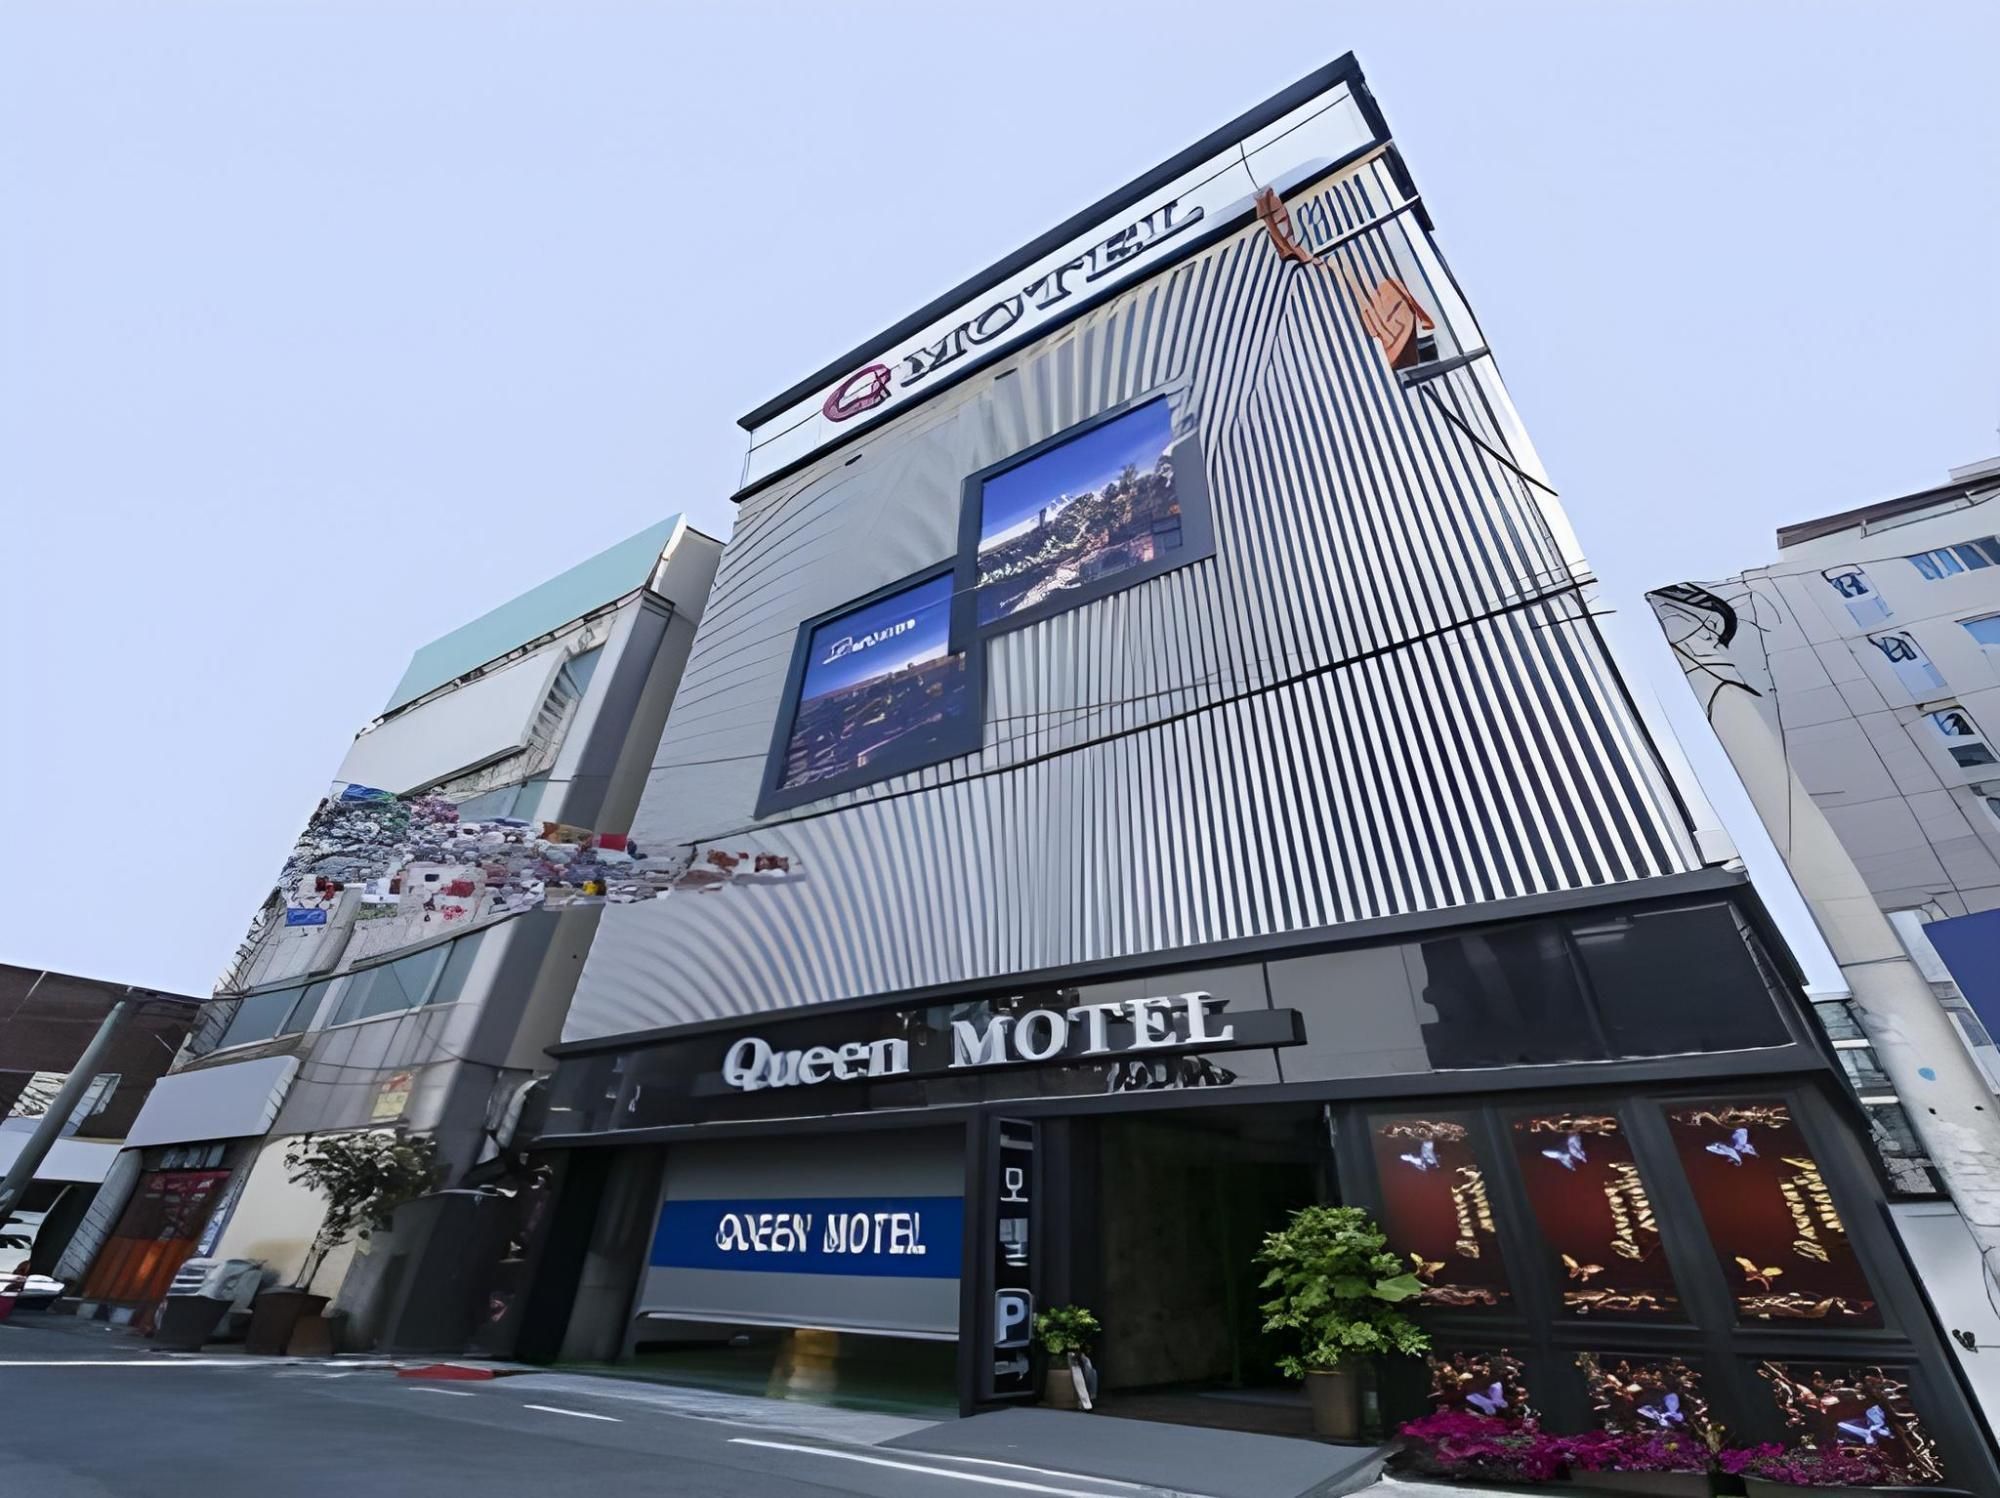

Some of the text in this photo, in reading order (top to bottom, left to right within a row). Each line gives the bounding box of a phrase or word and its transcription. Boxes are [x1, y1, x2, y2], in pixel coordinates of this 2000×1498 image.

[900, 201, 1203, 387] MOTEL
[722, 991, 1235, 1092] Queen MOTEL
[998, 1296, 1026, 1342] P
